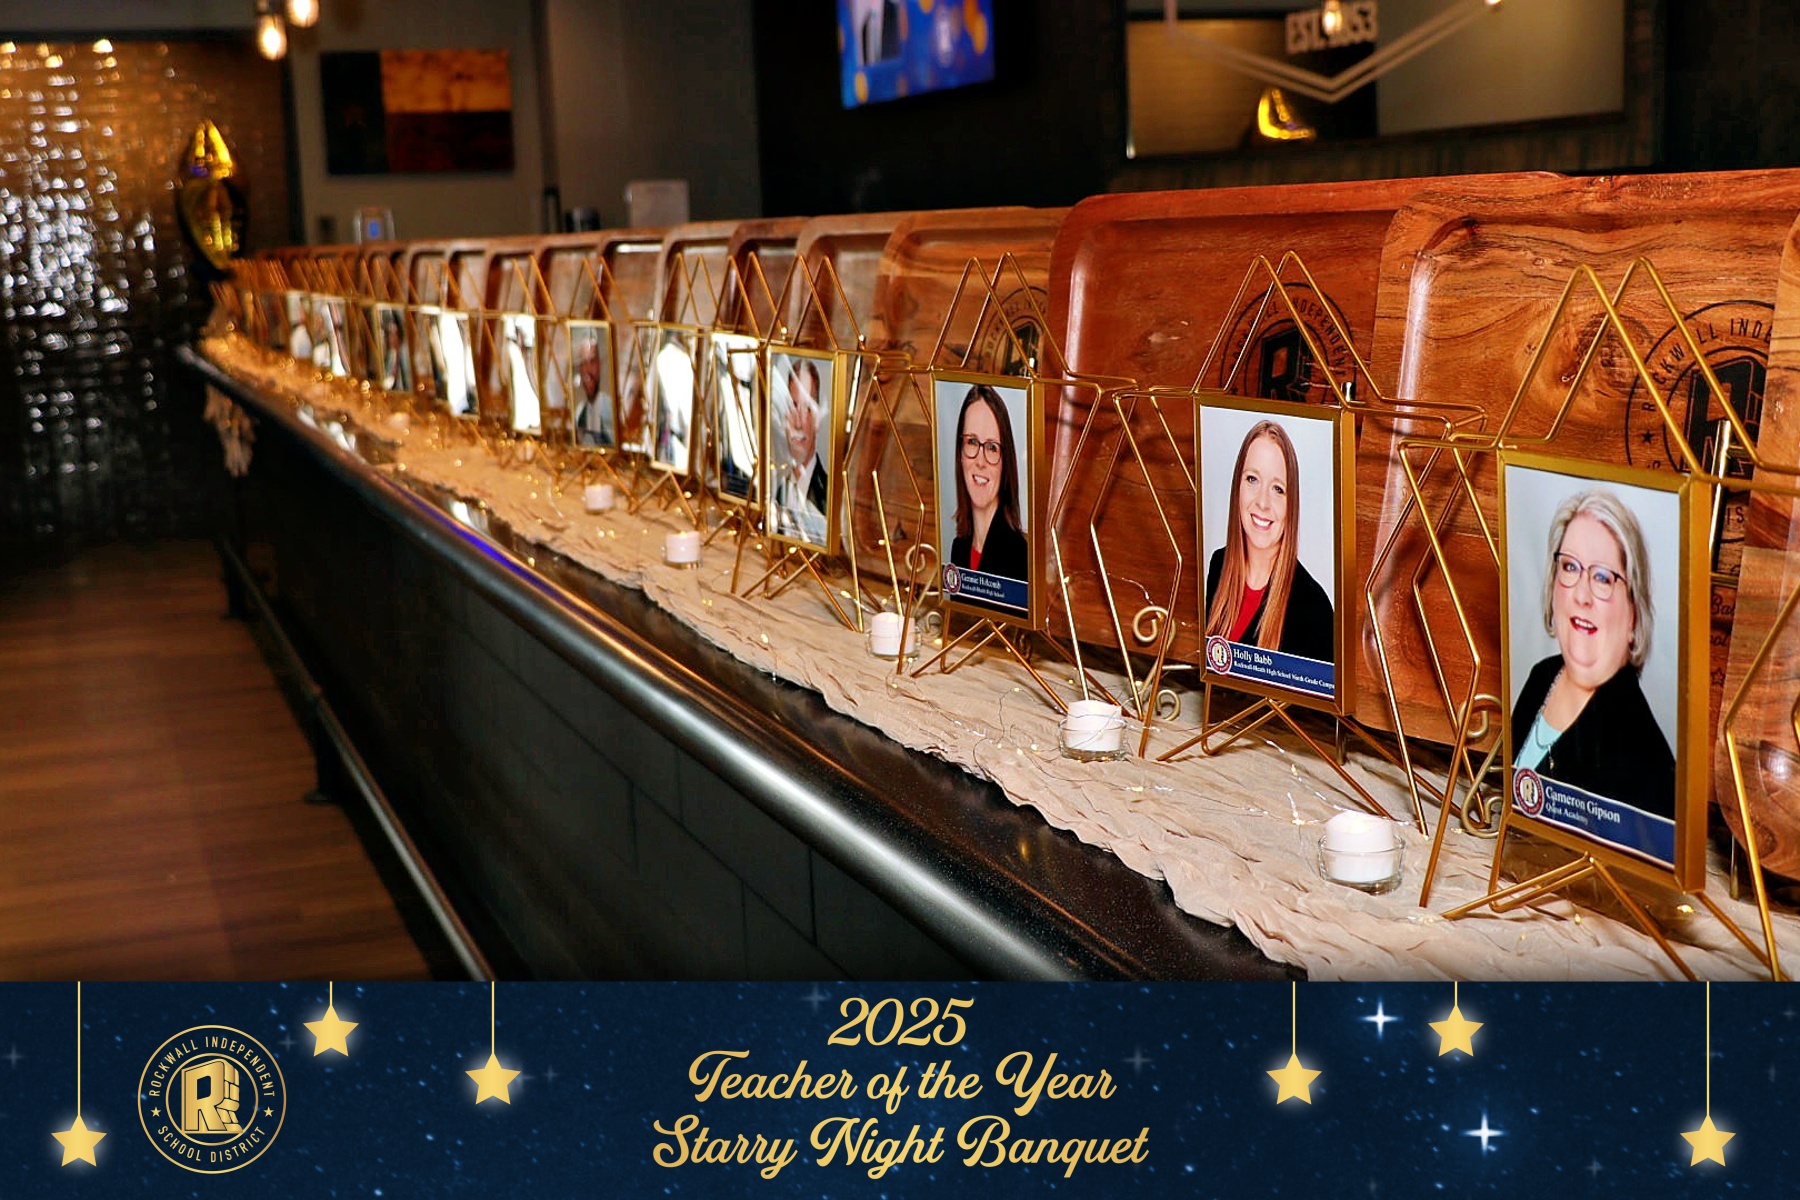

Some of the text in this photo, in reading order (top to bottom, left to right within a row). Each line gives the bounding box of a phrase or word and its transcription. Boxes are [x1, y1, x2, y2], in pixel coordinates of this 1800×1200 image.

[1233, 648, 1273, 666] Holly Babb
[1545, 786, 1585, 811] Cameron
[1587, 800, 1621, 824] Gipson
